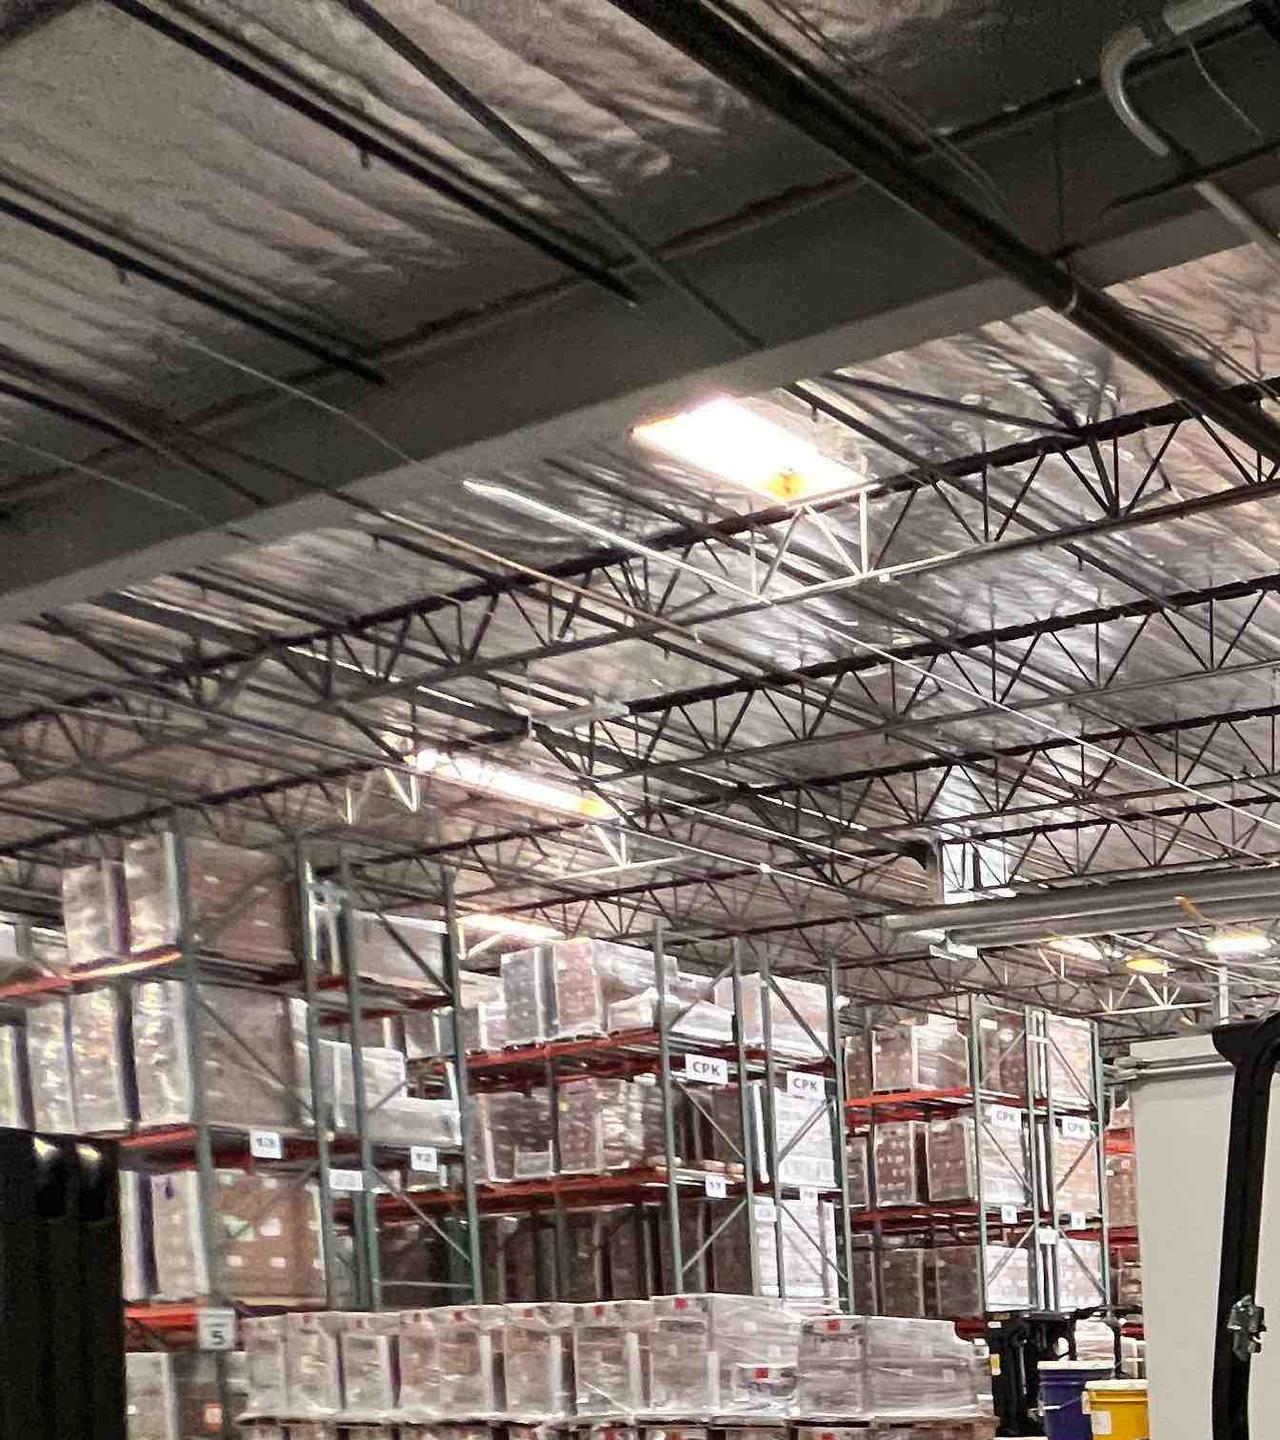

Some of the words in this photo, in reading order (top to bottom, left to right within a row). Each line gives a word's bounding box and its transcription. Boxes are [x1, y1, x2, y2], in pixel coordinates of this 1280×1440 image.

[692, 1061, 720, 1077] CPK
[793, 1078, 818, 1092] CPK
[211, 1330, 226, 1345] 5
